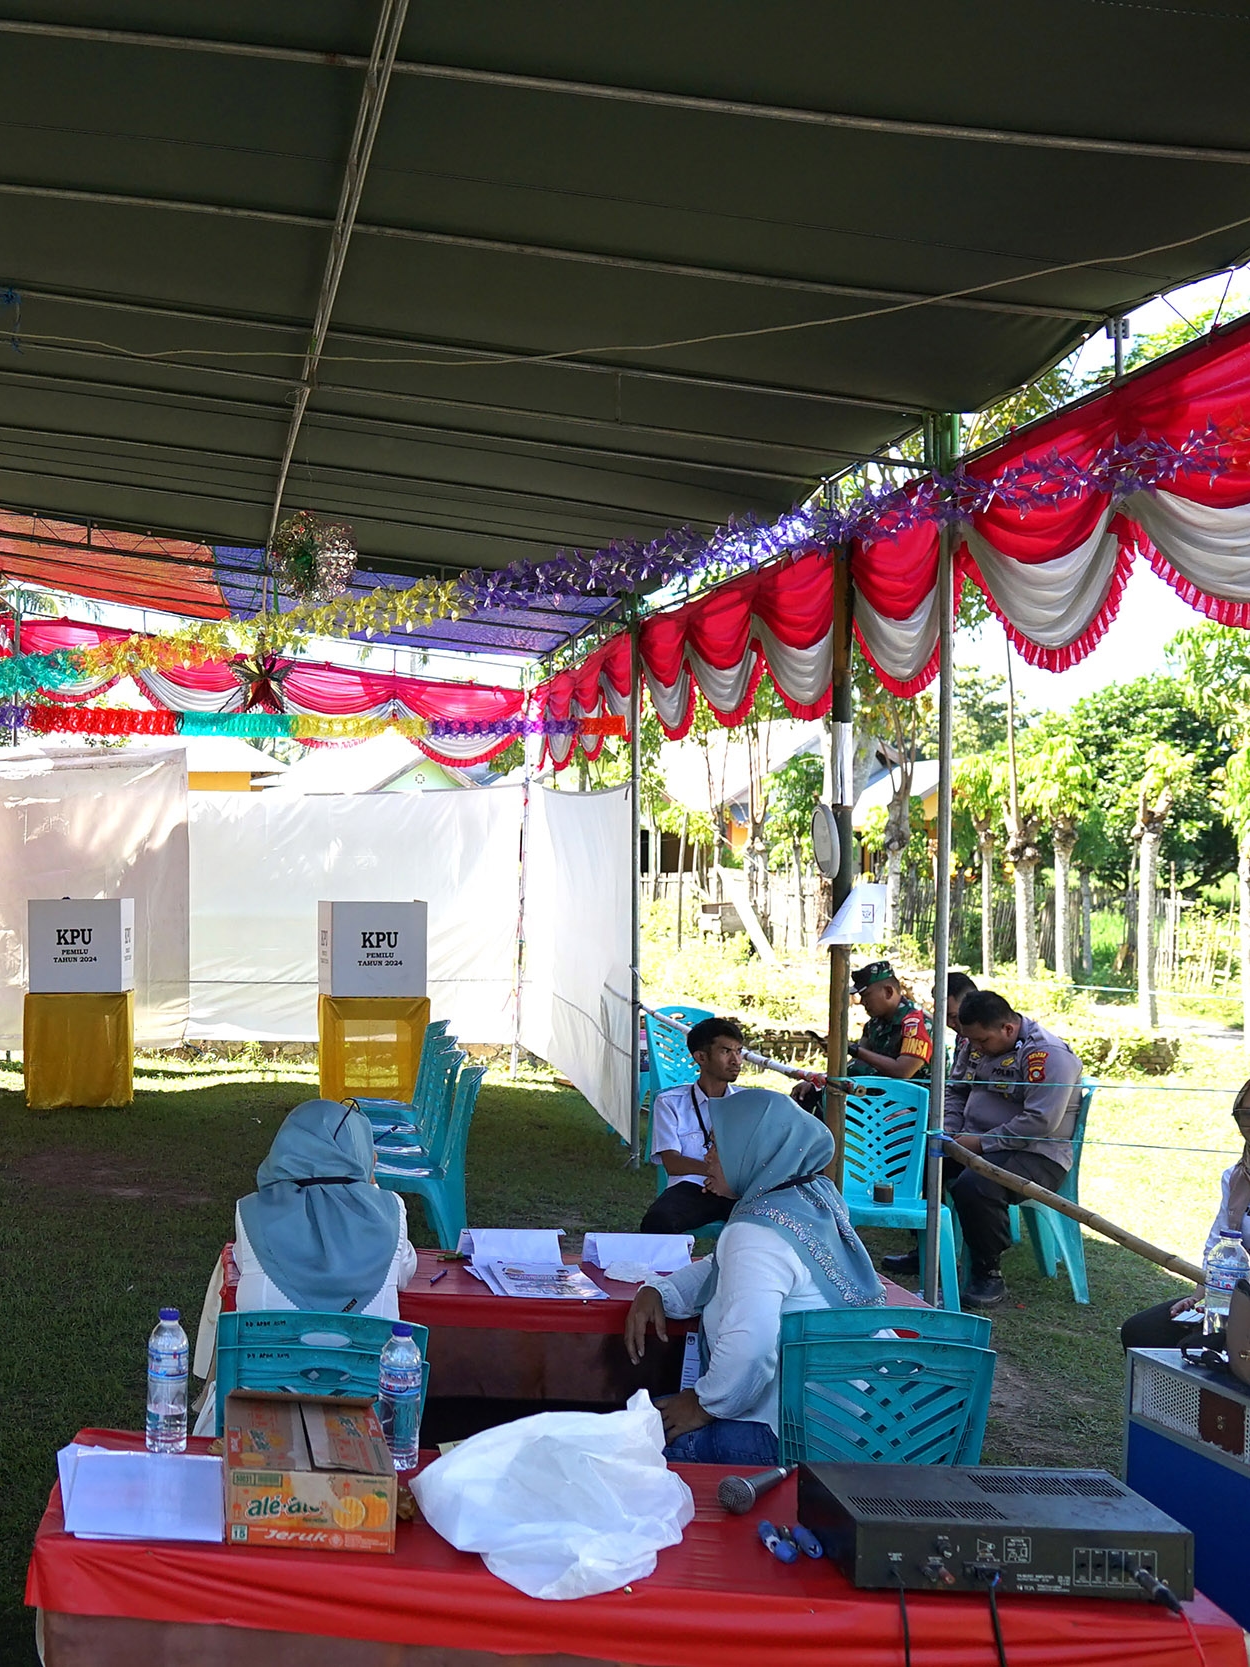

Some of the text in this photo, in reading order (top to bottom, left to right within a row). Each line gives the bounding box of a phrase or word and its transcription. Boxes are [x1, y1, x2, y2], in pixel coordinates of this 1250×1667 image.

[56, 928, 93, 946] KPU
[361, 931, 398, 948] KPU
[264, 1529, 328, 1543] Jeruk
